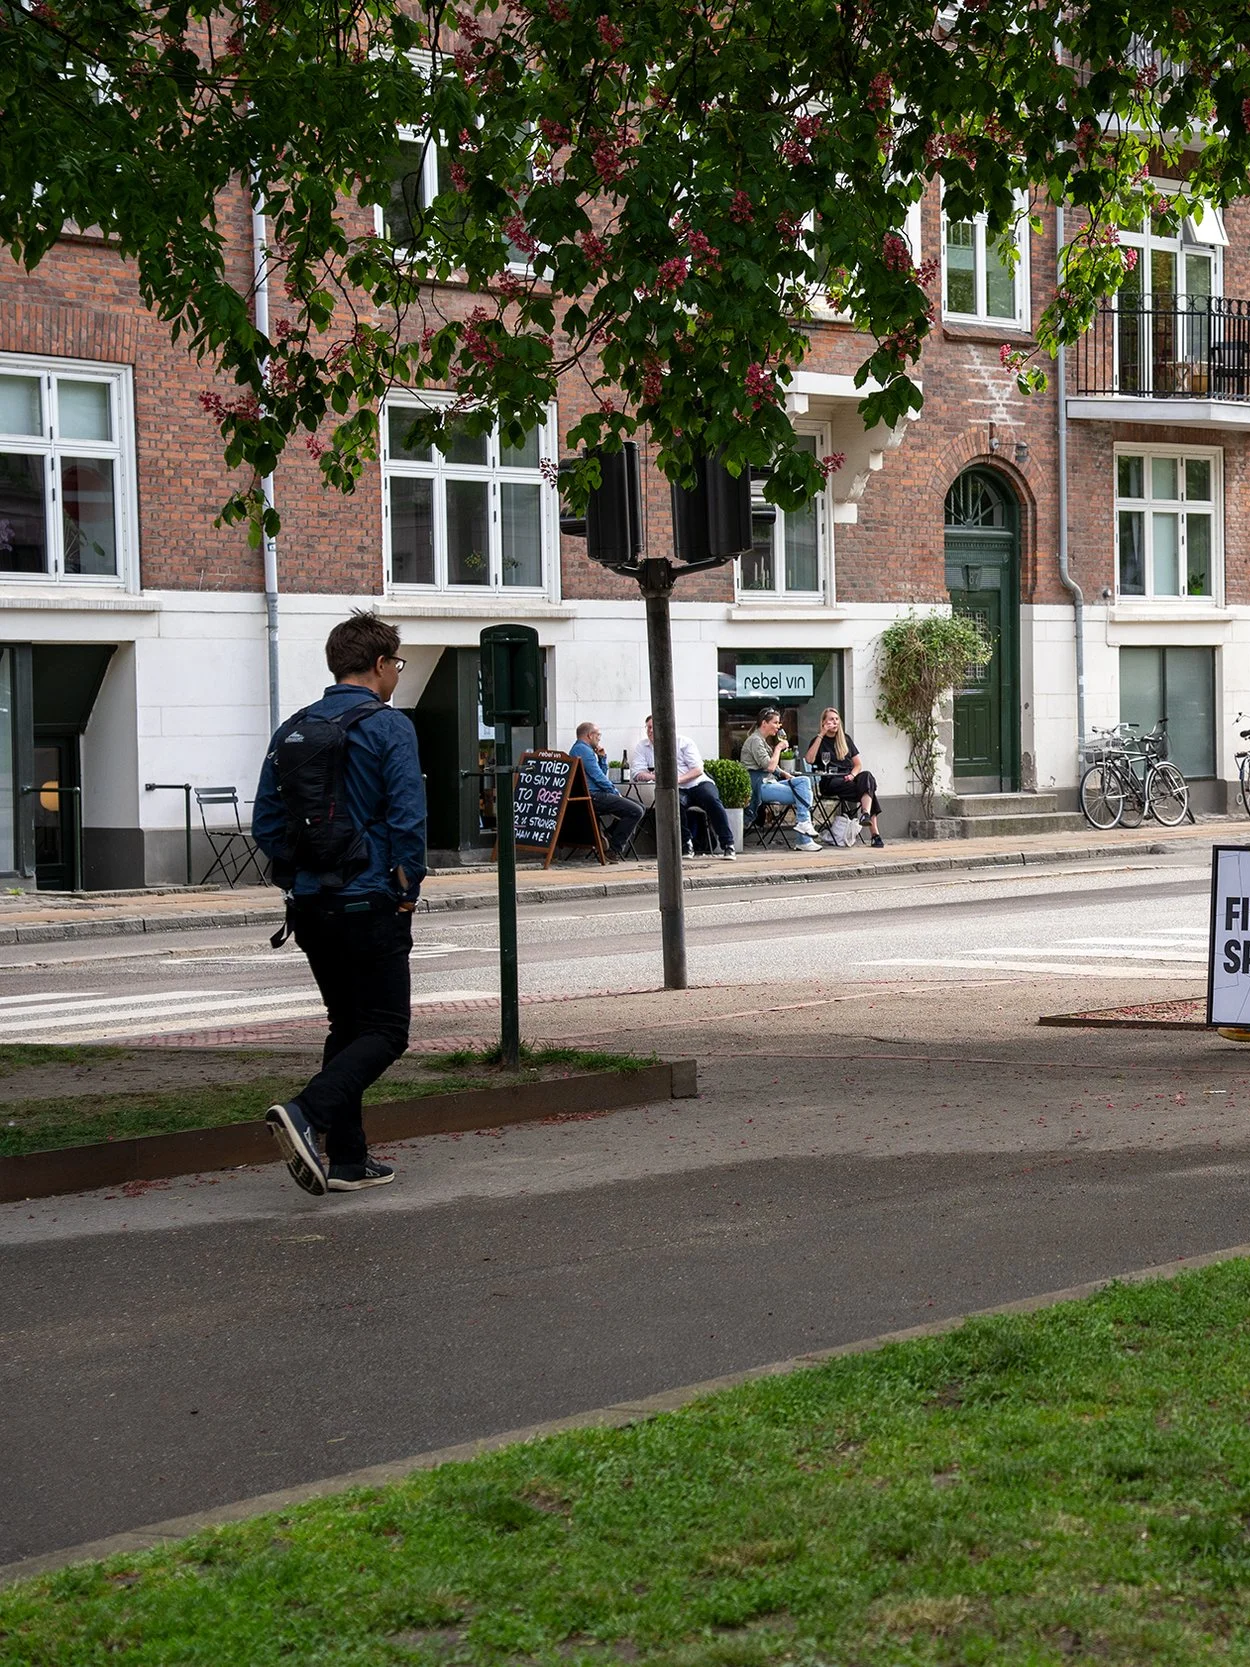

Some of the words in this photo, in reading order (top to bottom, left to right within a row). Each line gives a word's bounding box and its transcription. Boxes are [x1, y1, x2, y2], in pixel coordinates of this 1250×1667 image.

[744, 672, 782, 689] rebel
[786, 676, 806, 689] vin
[520, 773, 533, 784] TO
[533, 775, 551, 786] SAY
[552, 777, 566, 788] NO
[518, 787, 533, 800] TO
[513, 801, 533, 813] BUT
